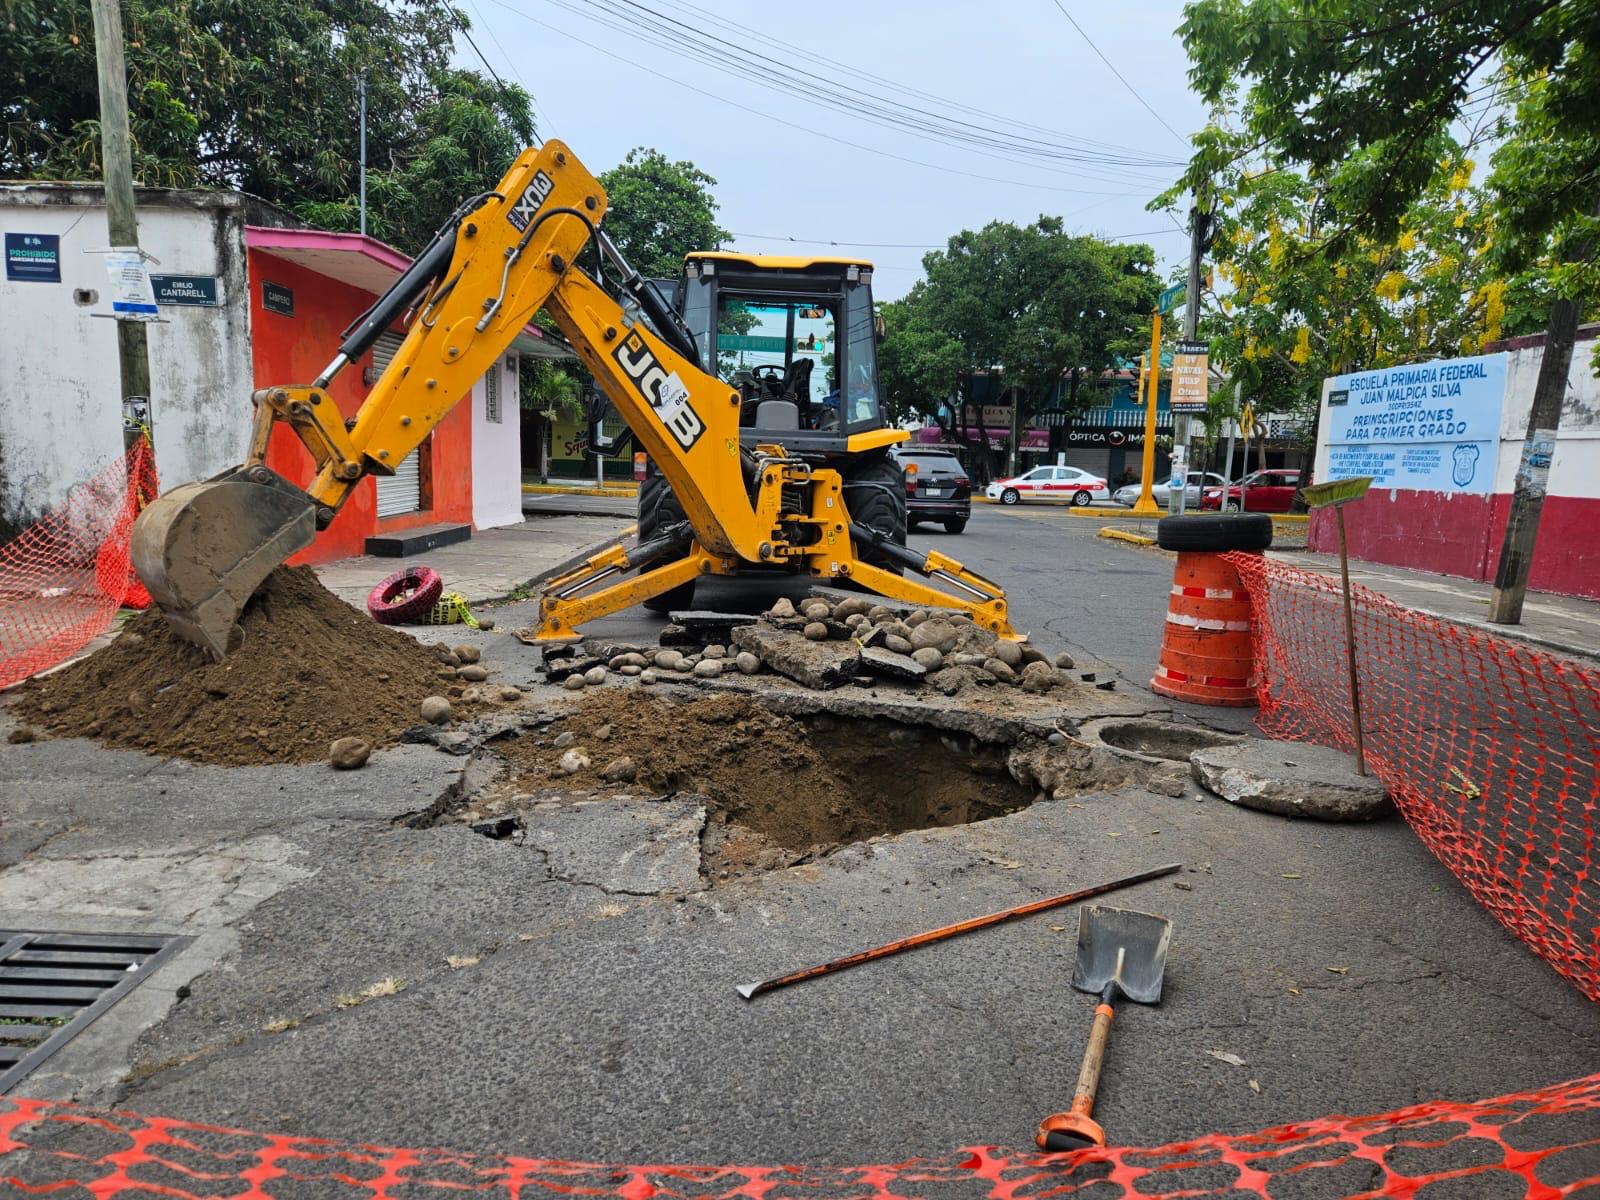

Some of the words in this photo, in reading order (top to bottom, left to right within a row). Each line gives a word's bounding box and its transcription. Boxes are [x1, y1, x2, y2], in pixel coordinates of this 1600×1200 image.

[9, 249, 56, 258] PROHIBIDO
[160, 288, 207, 298] CANTARELL
[172, 281, 193, 289] EMILIO
[1350, 375, 1388, 391] ESCUELA
[1391, 368, 1437, 386] PRIMARIA
[1440, 363, 1487, 381] FEDERAL
[618, 344, 701, 447] JCB
[674, 391, 688, 406] 004
[1360, 390, 1382, 405] JUAN
[1386, 386, 1427, 402] MALPICA
[1431, 382, 1461, 398] SILVA
[1353, 408, 1453, 427] PREINSCRIPCIONES
[1069, 430, 1106, 441] ÓPTICA
[1345, 428, 1369, 440] PARA
[1373, 425, 1415, 439] PRIMER
[1418, 421, 1467, 438] GRADO
